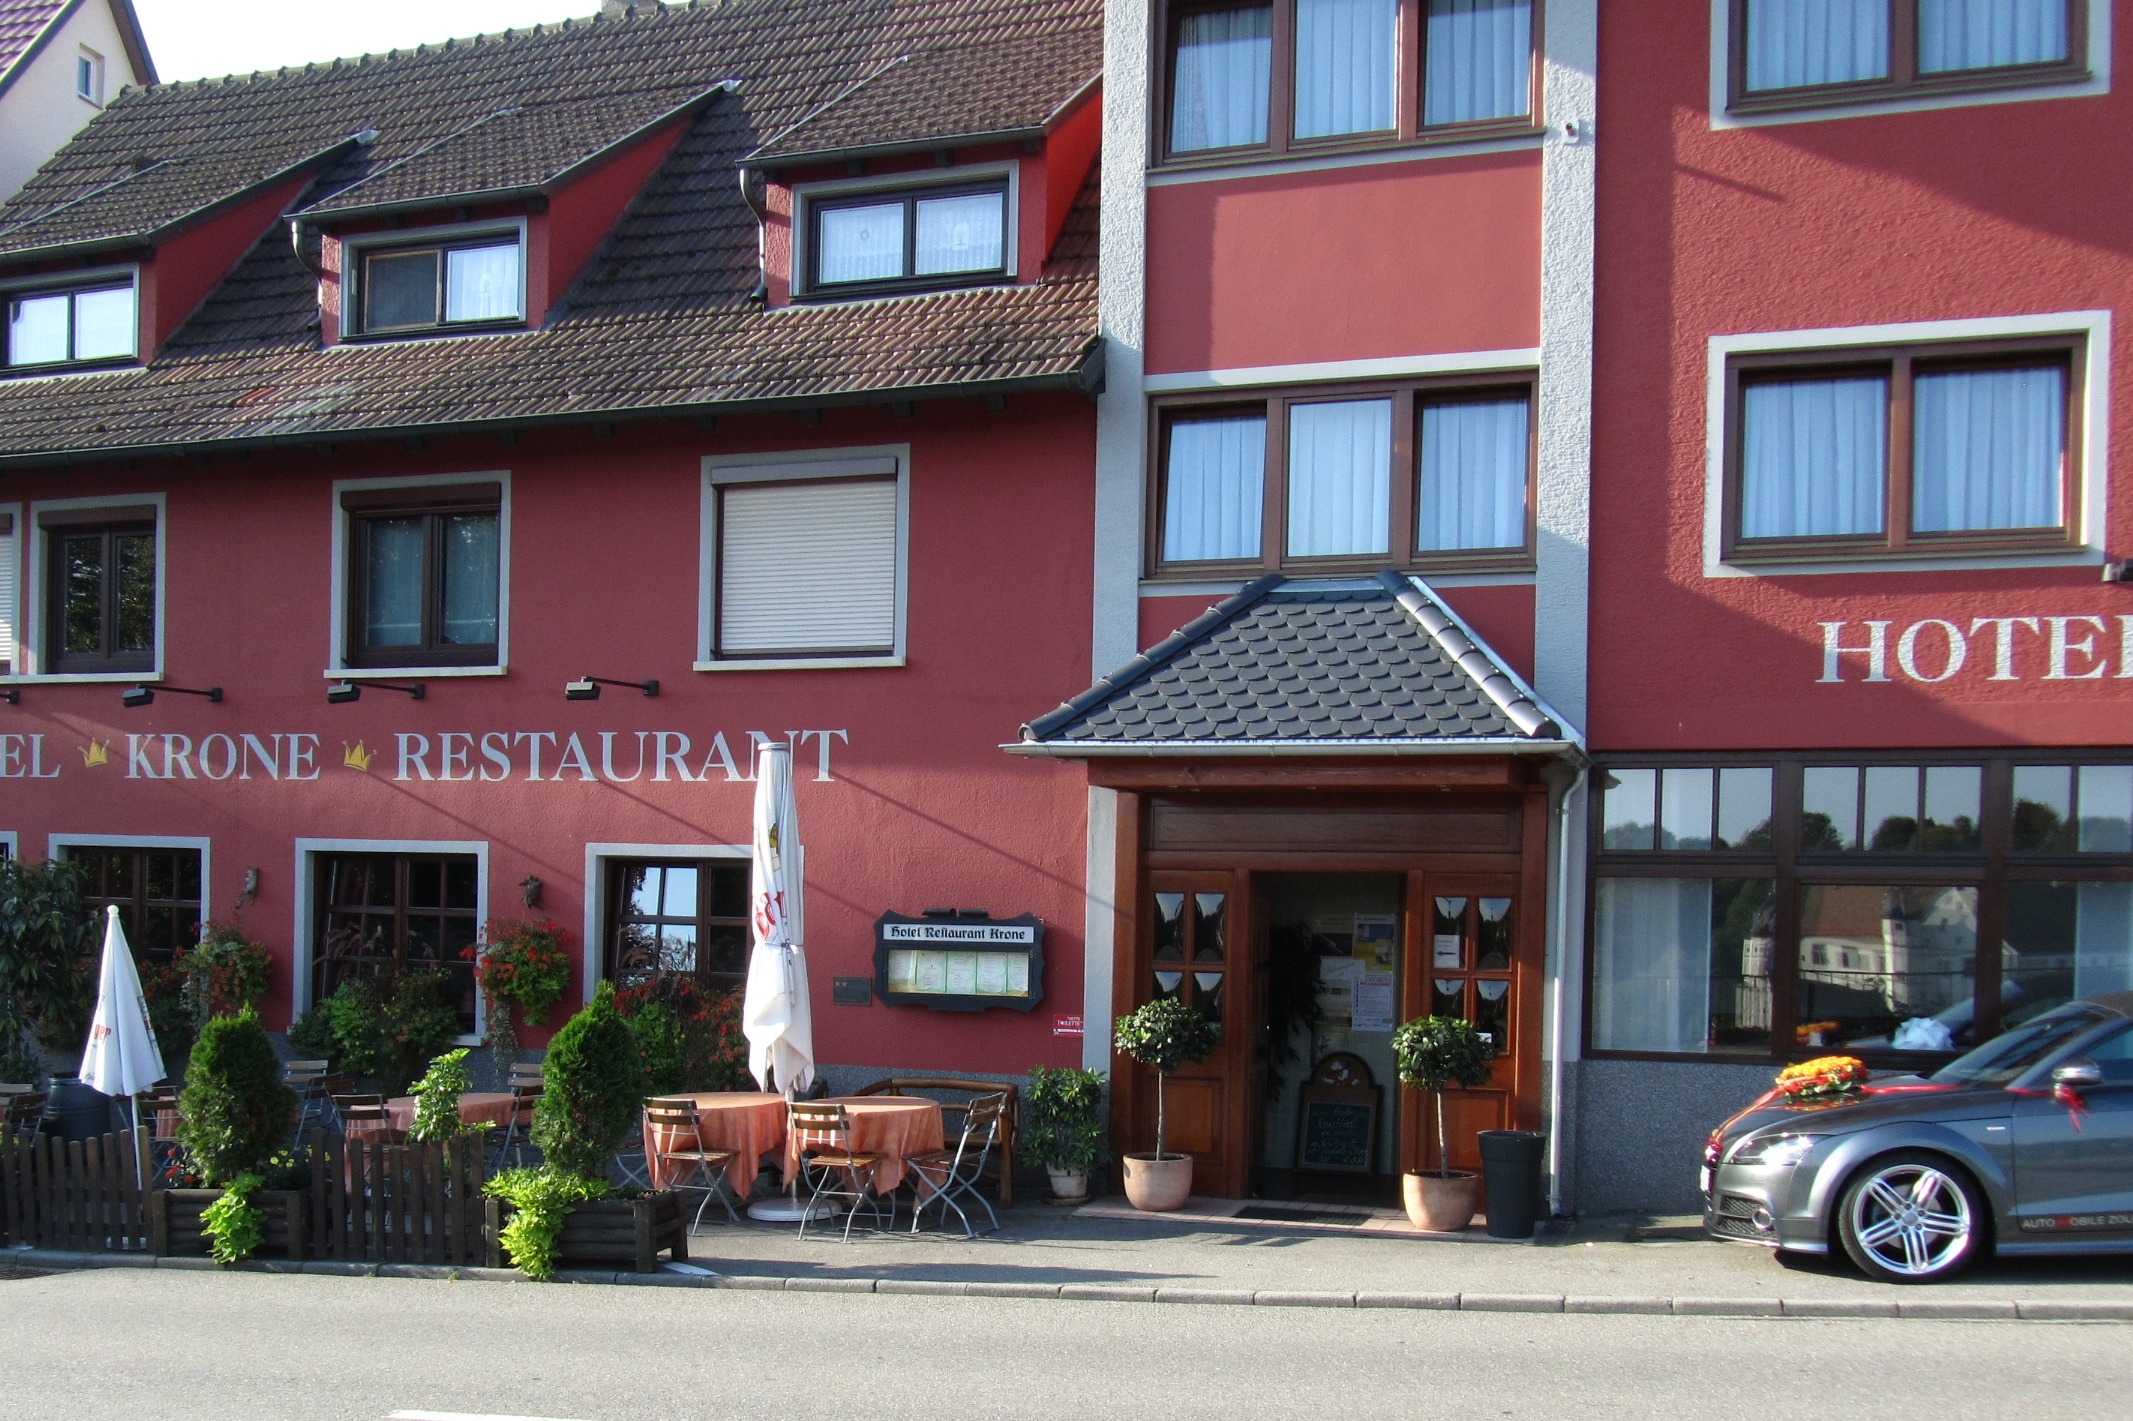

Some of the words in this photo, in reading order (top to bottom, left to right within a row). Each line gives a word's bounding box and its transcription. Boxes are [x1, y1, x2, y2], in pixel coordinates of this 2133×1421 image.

[125, 732, 321, 781] KRONE
[393, 729, 849, 782] RESTAURANT
[890, 926, 921, 938] Hotel
[924, 926, 985, 939] Restaurant
[989, 928, 1026, 940] Krone
[2108, 1214, 2133, 1224] ZOL
